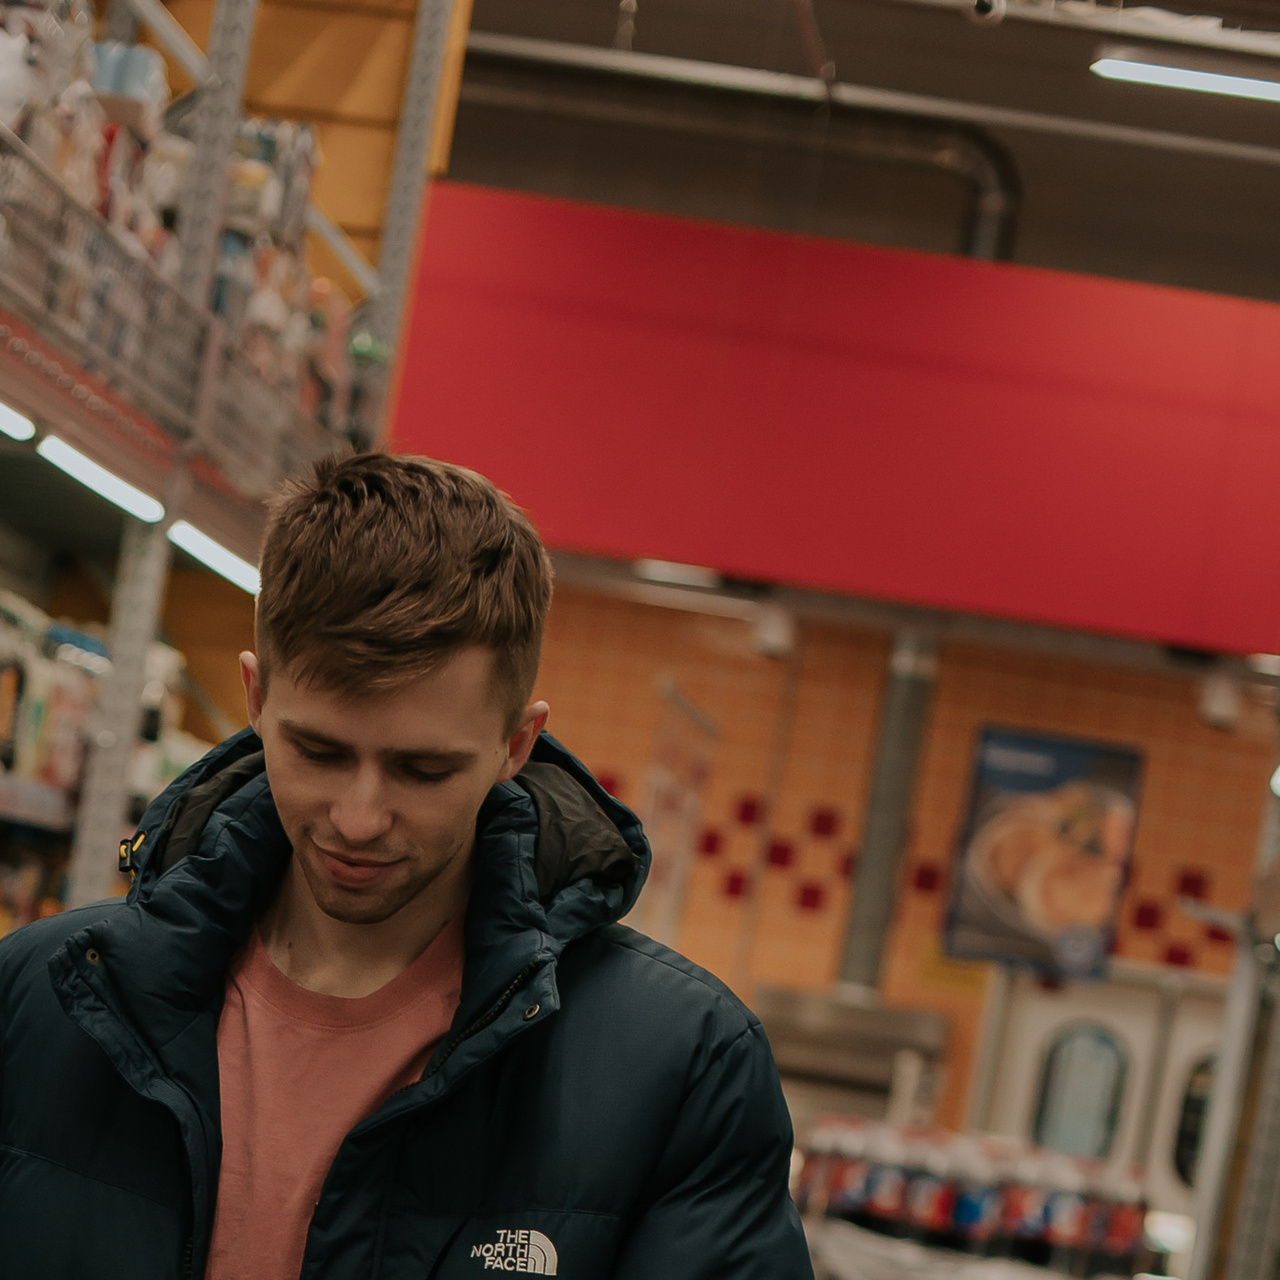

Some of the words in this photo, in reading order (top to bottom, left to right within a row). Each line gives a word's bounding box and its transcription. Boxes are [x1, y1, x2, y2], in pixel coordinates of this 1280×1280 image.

[496, 1229, 529, 1244] THE
[470, 1243, 528, 1258] NORTH
[484, 1256, 528, 1272] FACE
